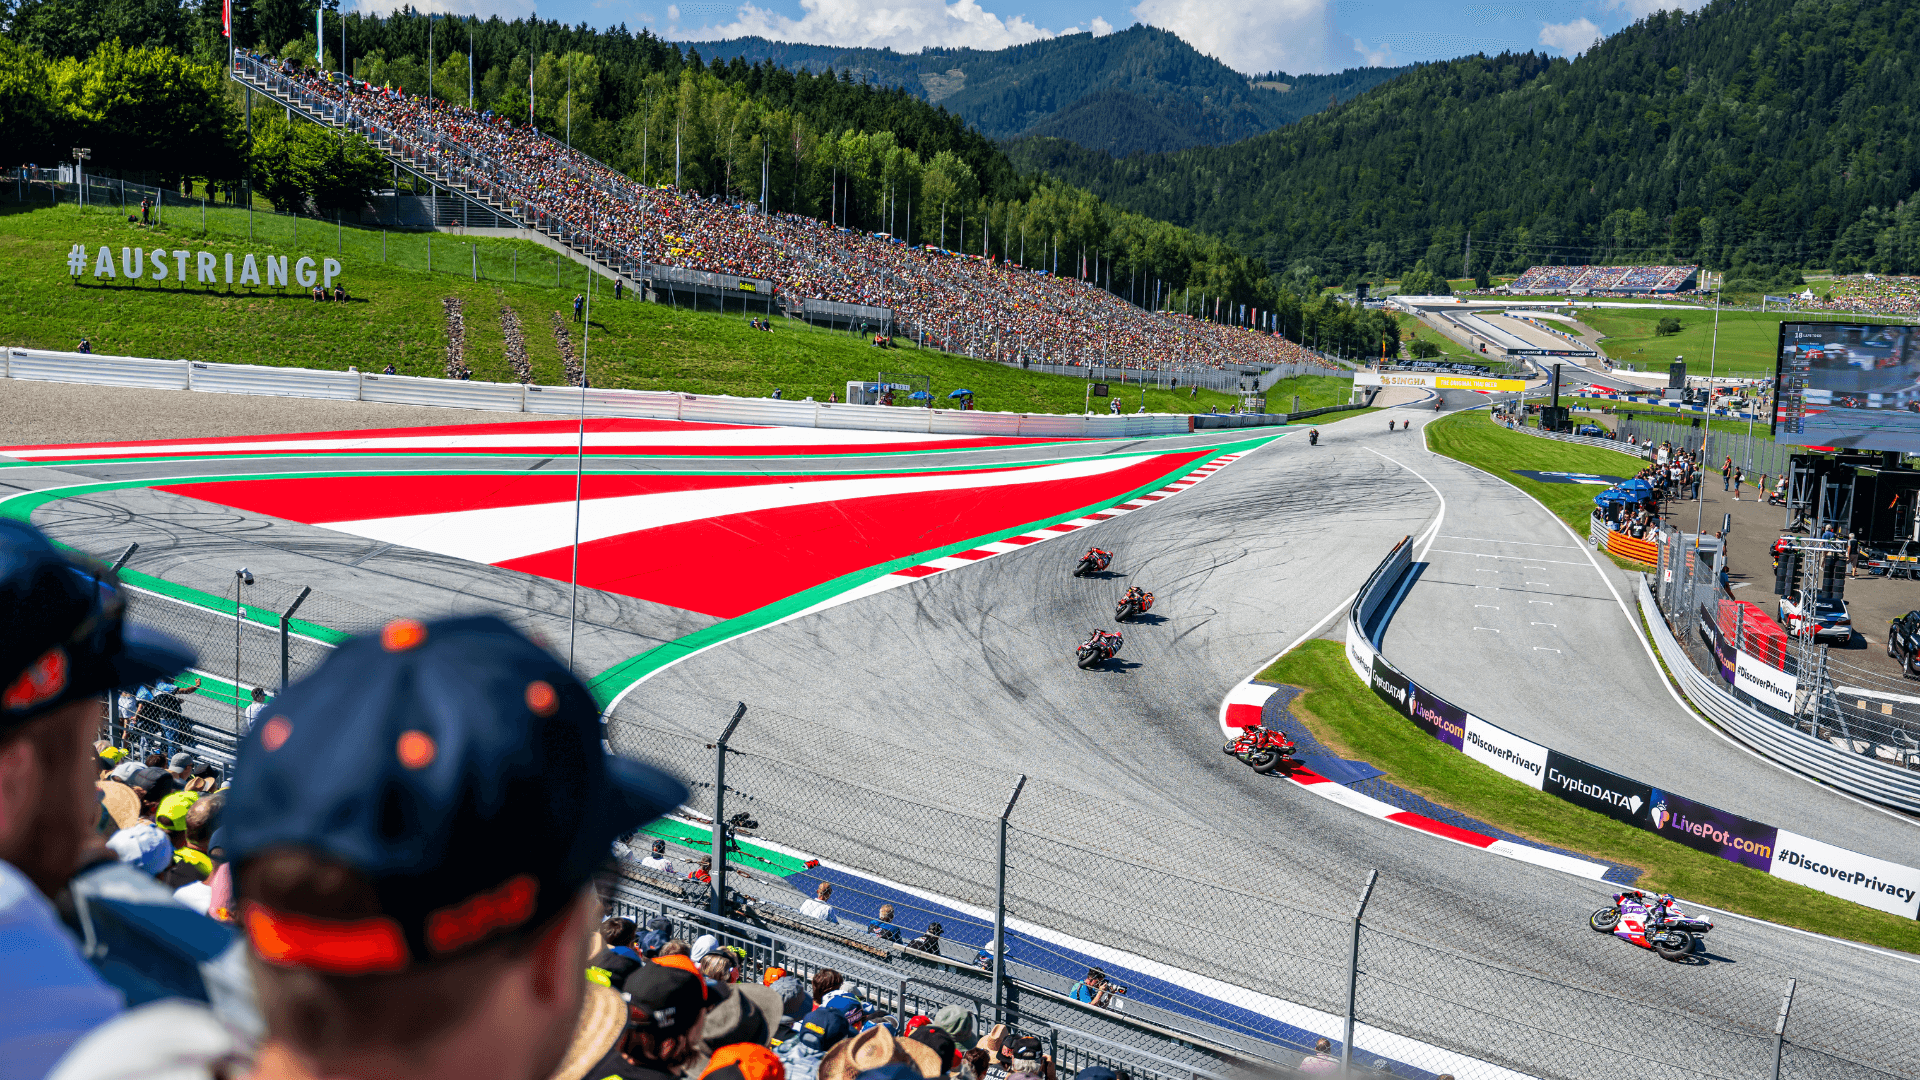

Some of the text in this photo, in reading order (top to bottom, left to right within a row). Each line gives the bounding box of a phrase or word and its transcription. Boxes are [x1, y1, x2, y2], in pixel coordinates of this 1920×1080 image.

[67, 243, 342, 289] #AUSTRIANGP
[1391, 377, 1426, 386] SINGHA
[1372, 669, 1401, 701] CryptoDATA
[1737, 665, 1793, 702] #DiscoverPrivacy
[1416, 701, 1464, 738] LivePot.com
[1467, 730, 1542, 776] #DiscoverPrivacy
[1548, 767, 1632, 811] CryptoDATA
[1671, 812, 1771, 859] LivePot.com
[1778, 848, 1916, 903] #DiscoverPrivacy
